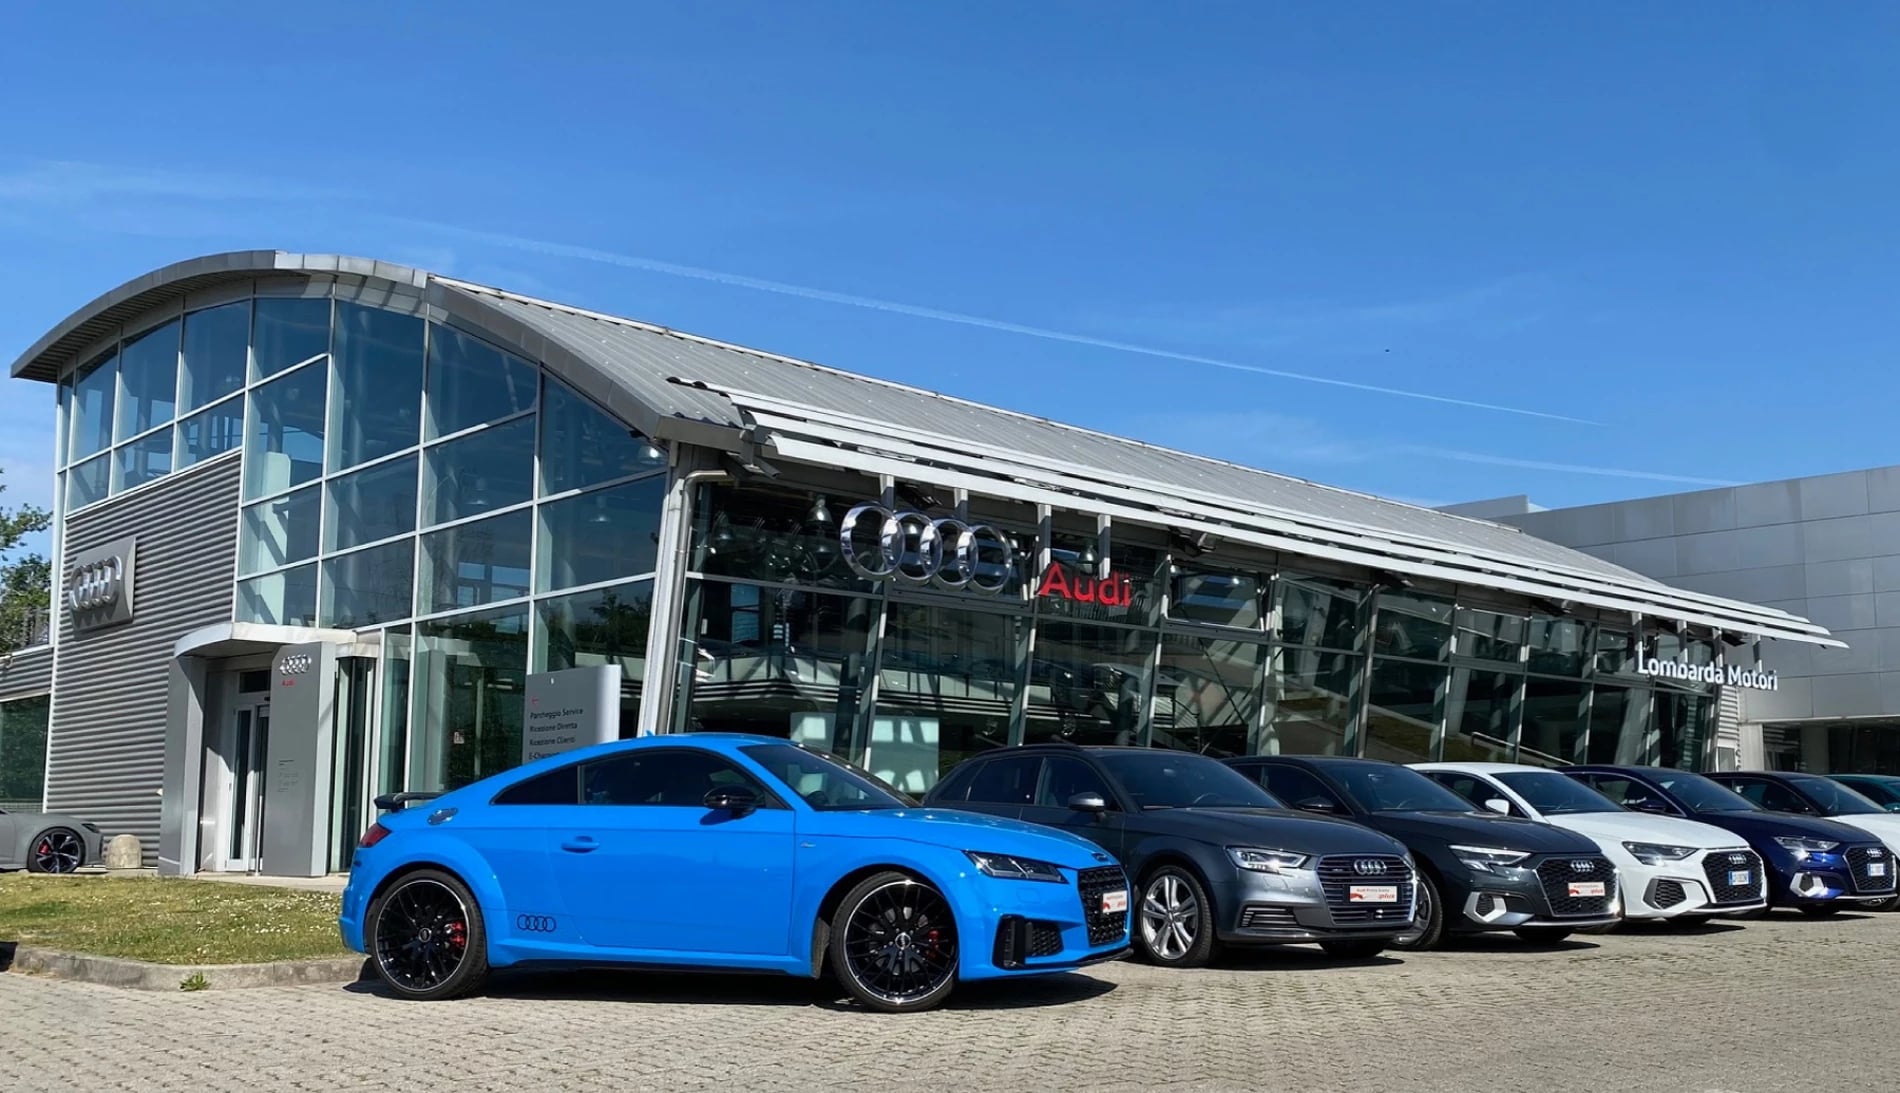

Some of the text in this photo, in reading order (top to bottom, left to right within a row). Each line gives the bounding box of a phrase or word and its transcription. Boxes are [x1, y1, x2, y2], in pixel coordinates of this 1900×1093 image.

[1039, 561, 1131, 607] Audi
[1638, 648, 1778, 691] Lombarda Motori
[529, 707, 584, 720] Parcheggio Service
